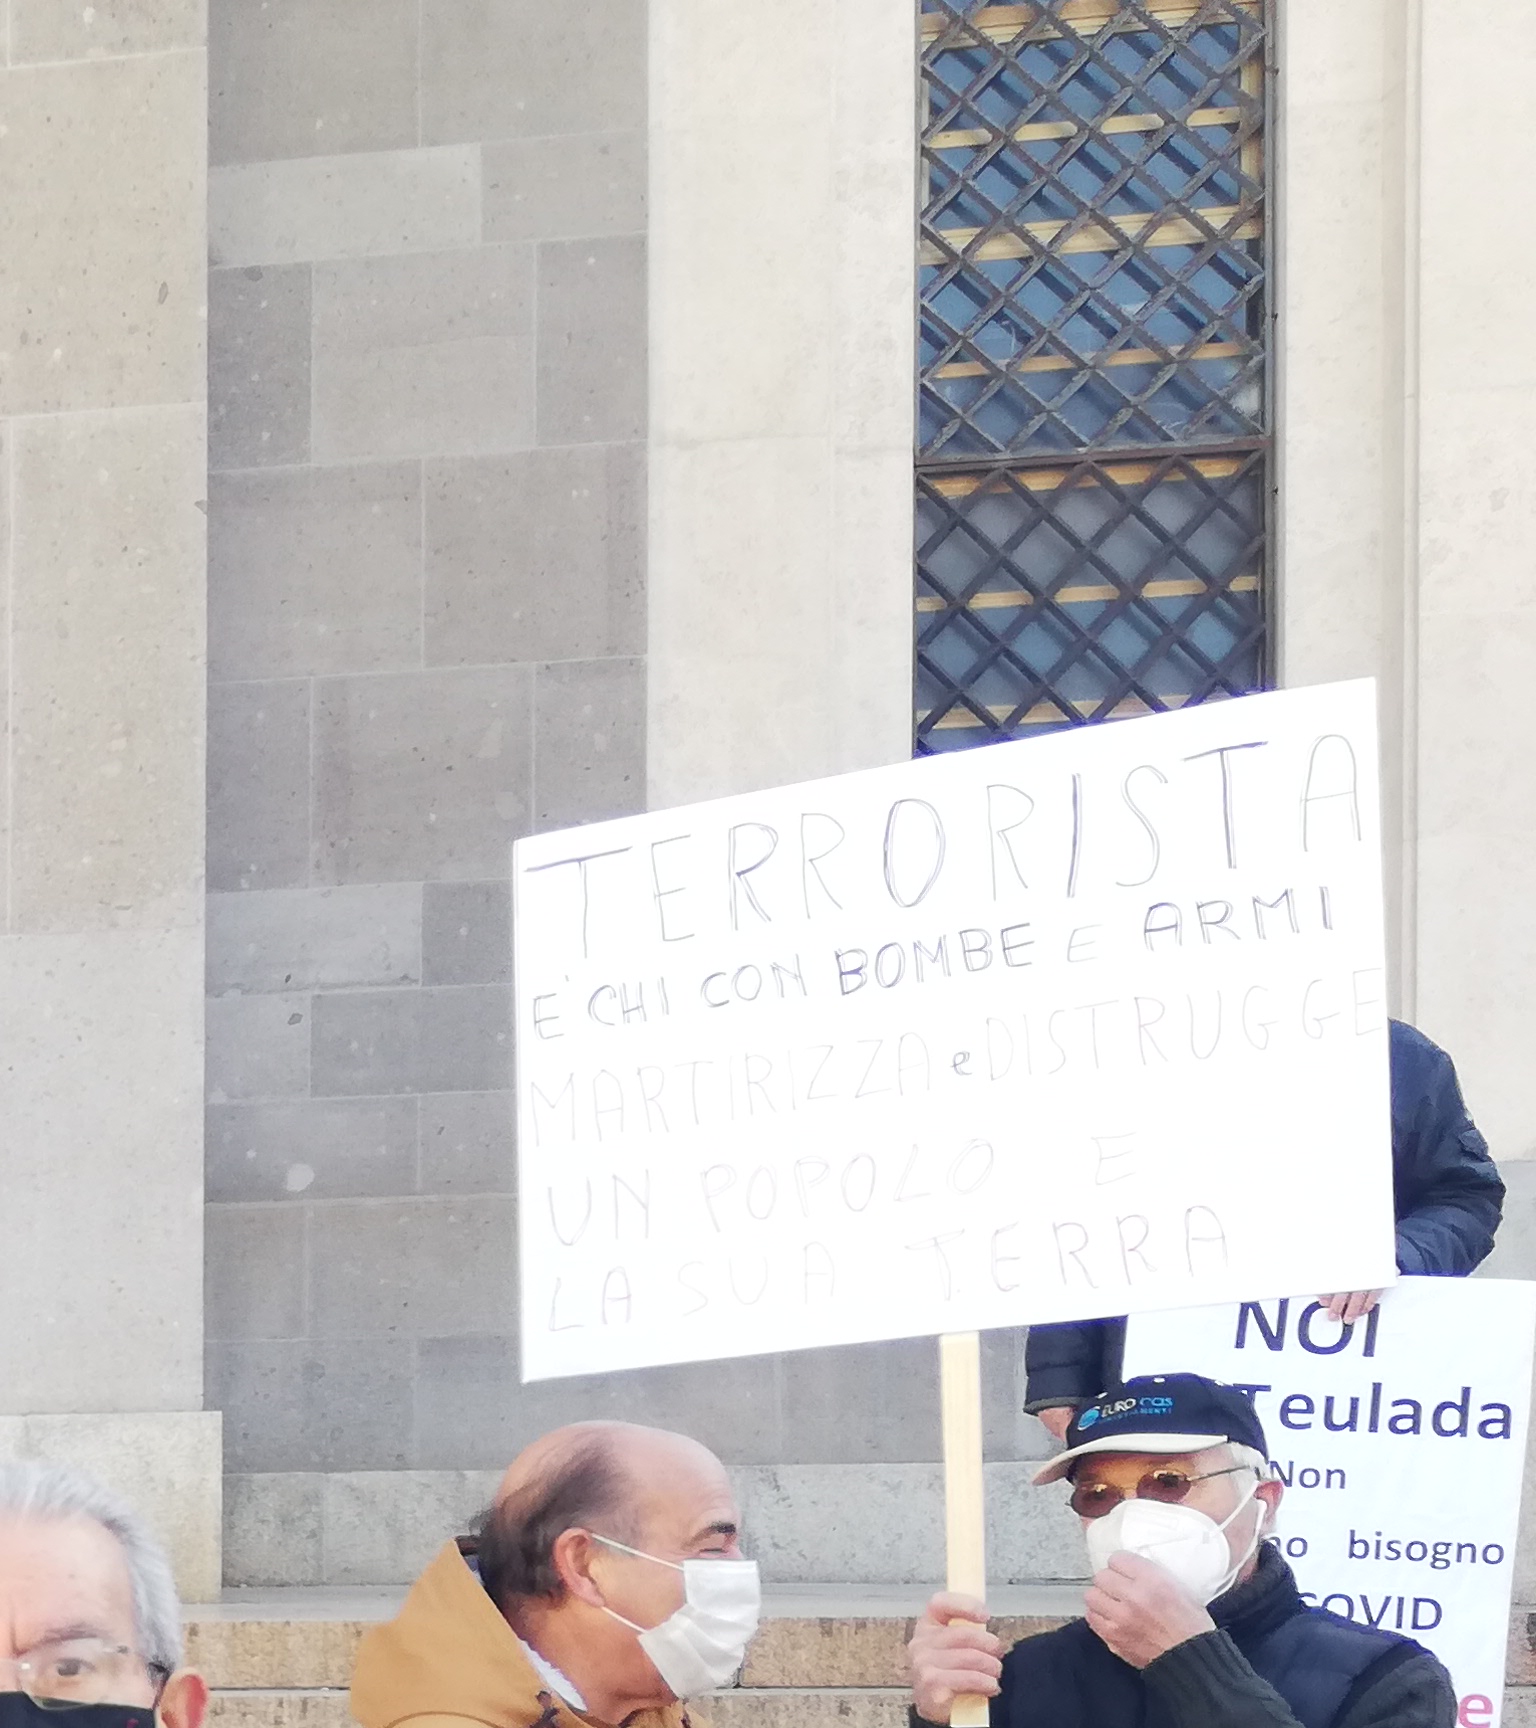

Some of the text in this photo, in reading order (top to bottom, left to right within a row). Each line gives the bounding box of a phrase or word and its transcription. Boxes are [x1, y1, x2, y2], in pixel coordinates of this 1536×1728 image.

[524, 733, 1363, 959] TERRORISTA
[586, 974, 671, 1029] CHI
[700, 953, 808, 1010] CON
[835, 921, 1038, 997] BOMBE
[1065, 922, 1103, 964] E
[1140, 885, 1335, 951] ARMI
[699, 1136, 996, 1234] POPOLO
[1233, 1298, 1381, 1357] NOI
[1347, 1529, 1505, 1570] bisogno
